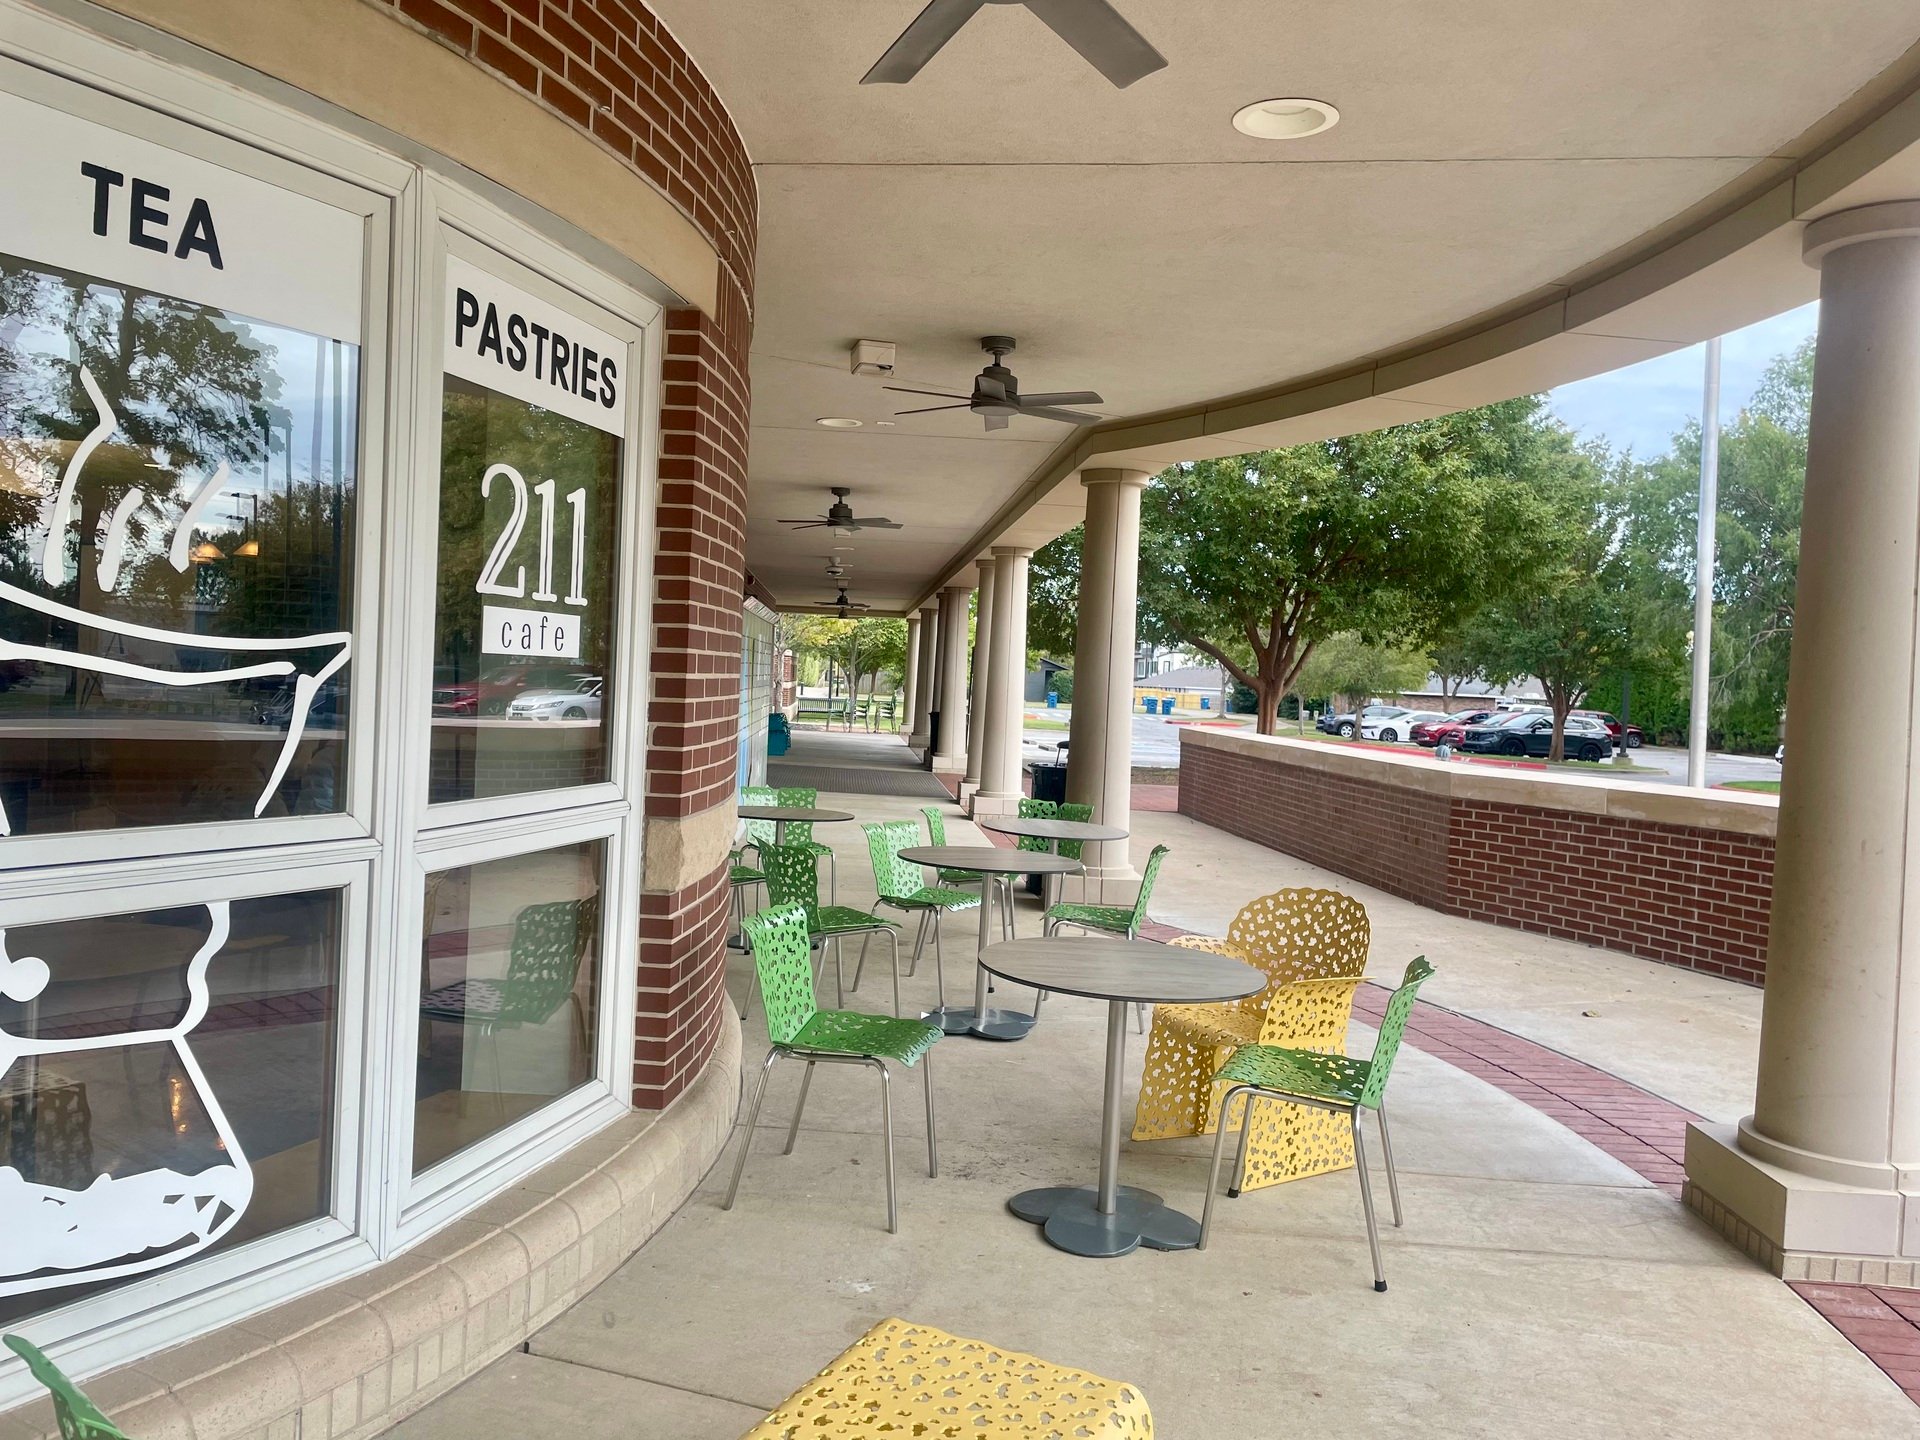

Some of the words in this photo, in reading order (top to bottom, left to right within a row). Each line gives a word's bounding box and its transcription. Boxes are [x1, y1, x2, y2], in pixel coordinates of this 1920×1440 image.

[81, 161, 224, 270] TEA
[455, 287, 618, 409] PASTRIES
[475, 463, 588, 606] 211
[501, 615, 565, 652] cafe
